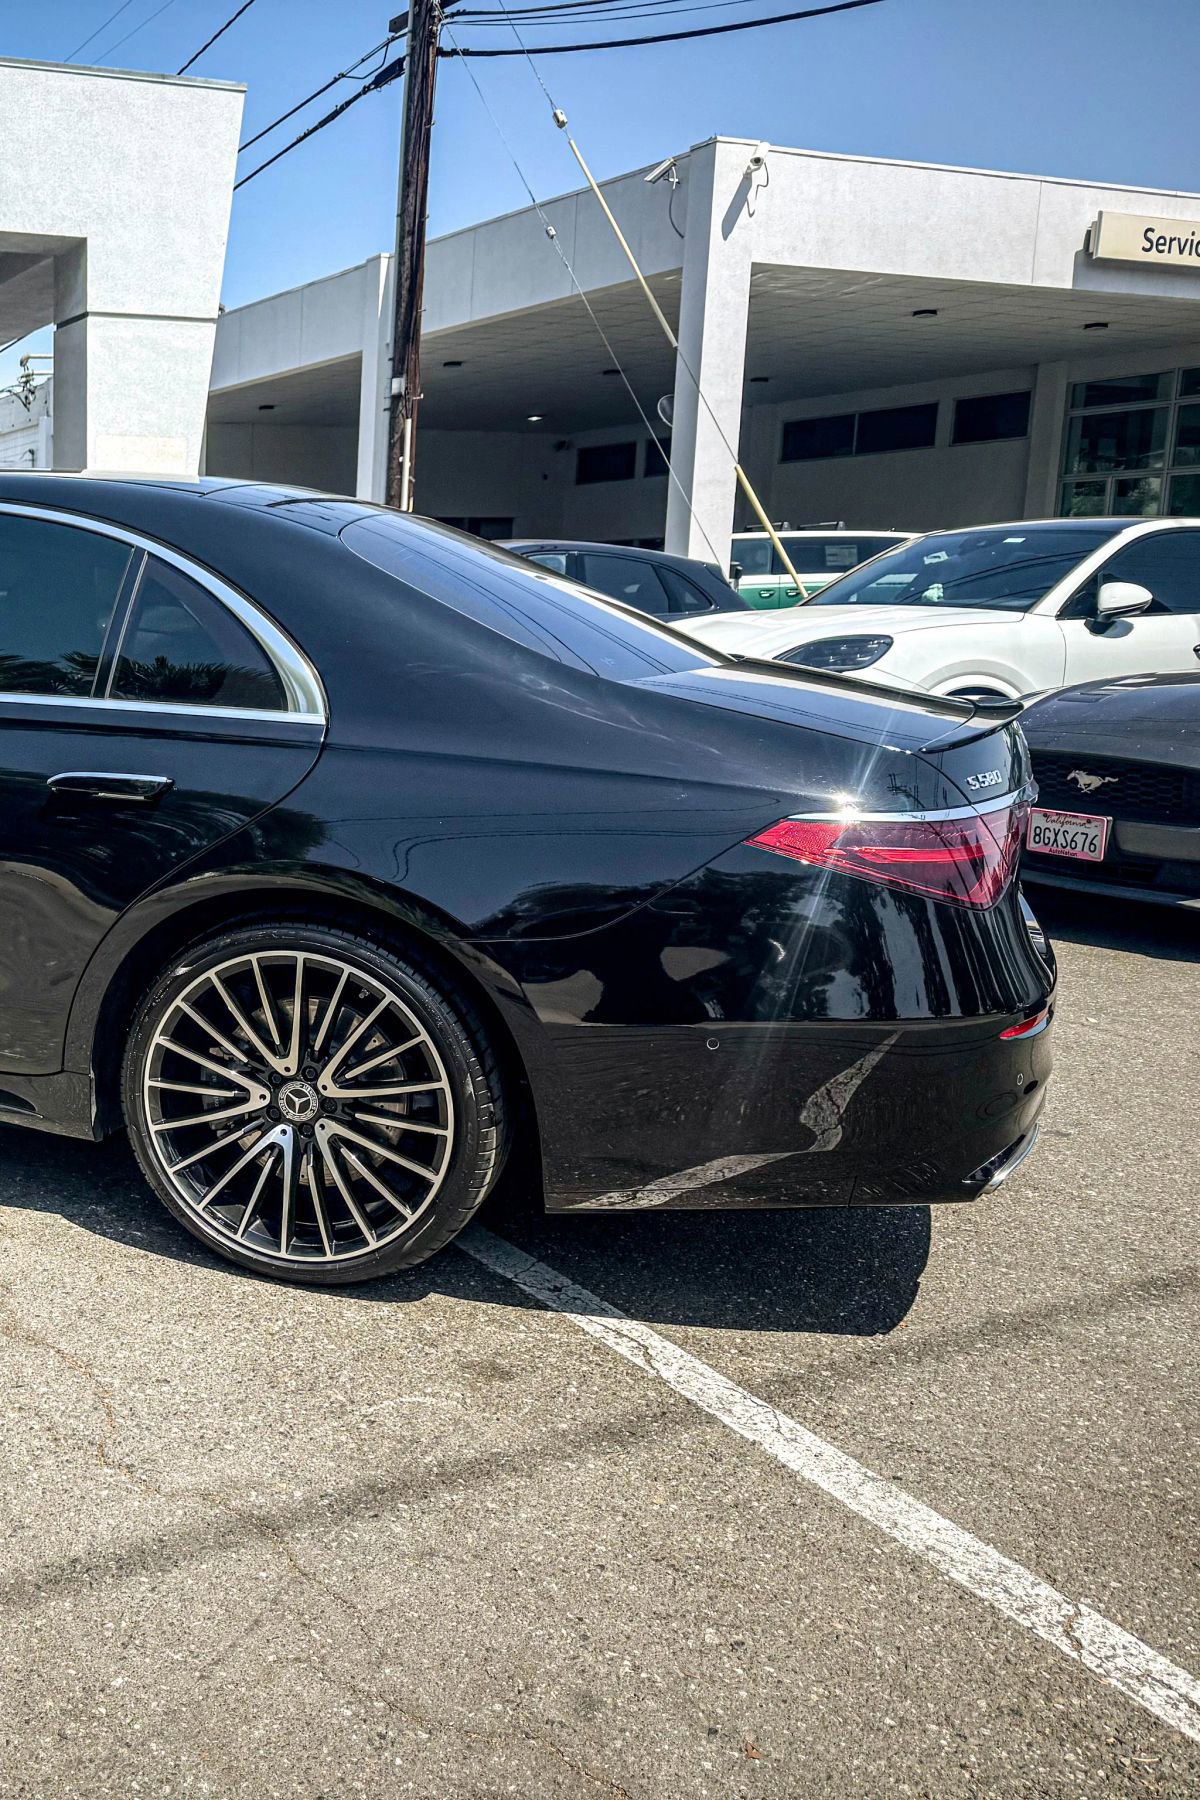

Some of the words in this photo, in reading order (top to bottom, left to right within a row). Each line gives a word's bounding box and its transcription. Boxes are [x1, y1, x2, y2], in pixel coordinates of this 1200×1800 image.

[1045, 814, 1090, 828] California
[1032, 826, 1099, 853] 8GXS676
[1048, 847, 1078, 857] AutoNation
